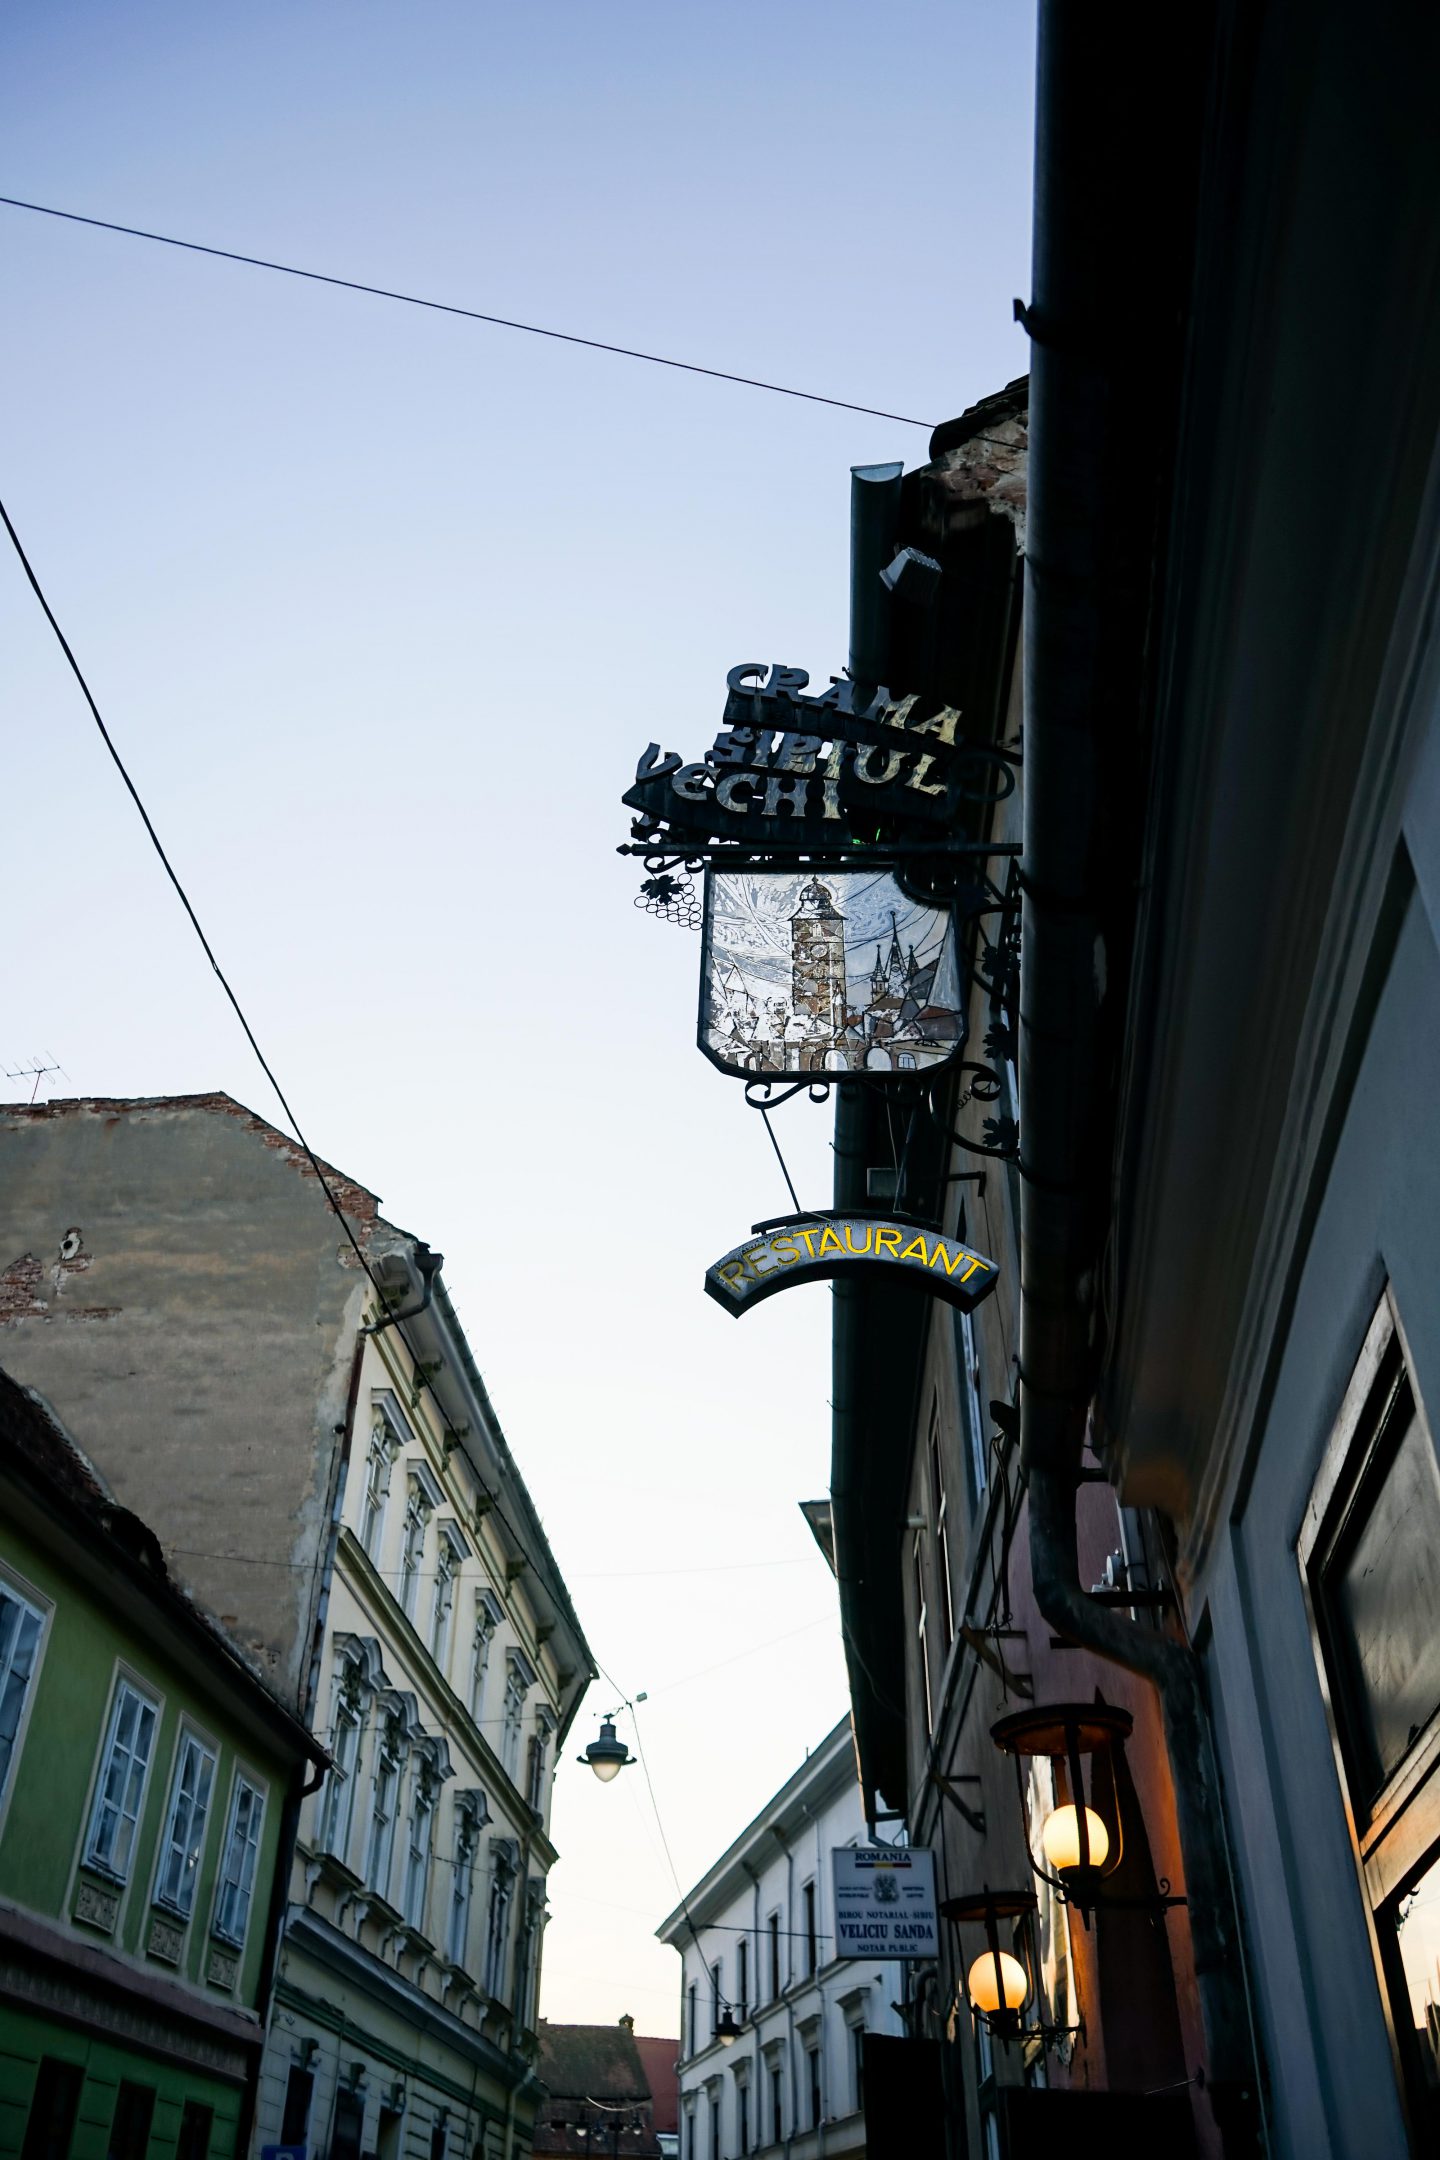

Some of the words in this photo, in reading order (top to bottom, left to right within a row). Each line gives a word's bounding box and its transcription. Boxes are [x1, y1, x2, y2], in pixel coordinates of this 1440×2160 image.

[726, 663, 963, 747] CRAMA
[635, 742, 843, 820] VECHI
[705, 726, 950, 797] SIBIUL
[716, 1226, 990, 1293] RESTAURANT
[855, 1852, 912, 1861] ROMANIA
[840, 1924, 888, 1939] VELICIU
[894, 1924, 934, 1939] SANDA
[857, 1944, 885, 1952] NOTAR
[888, 1944, 918, 1952] PUBLIC
